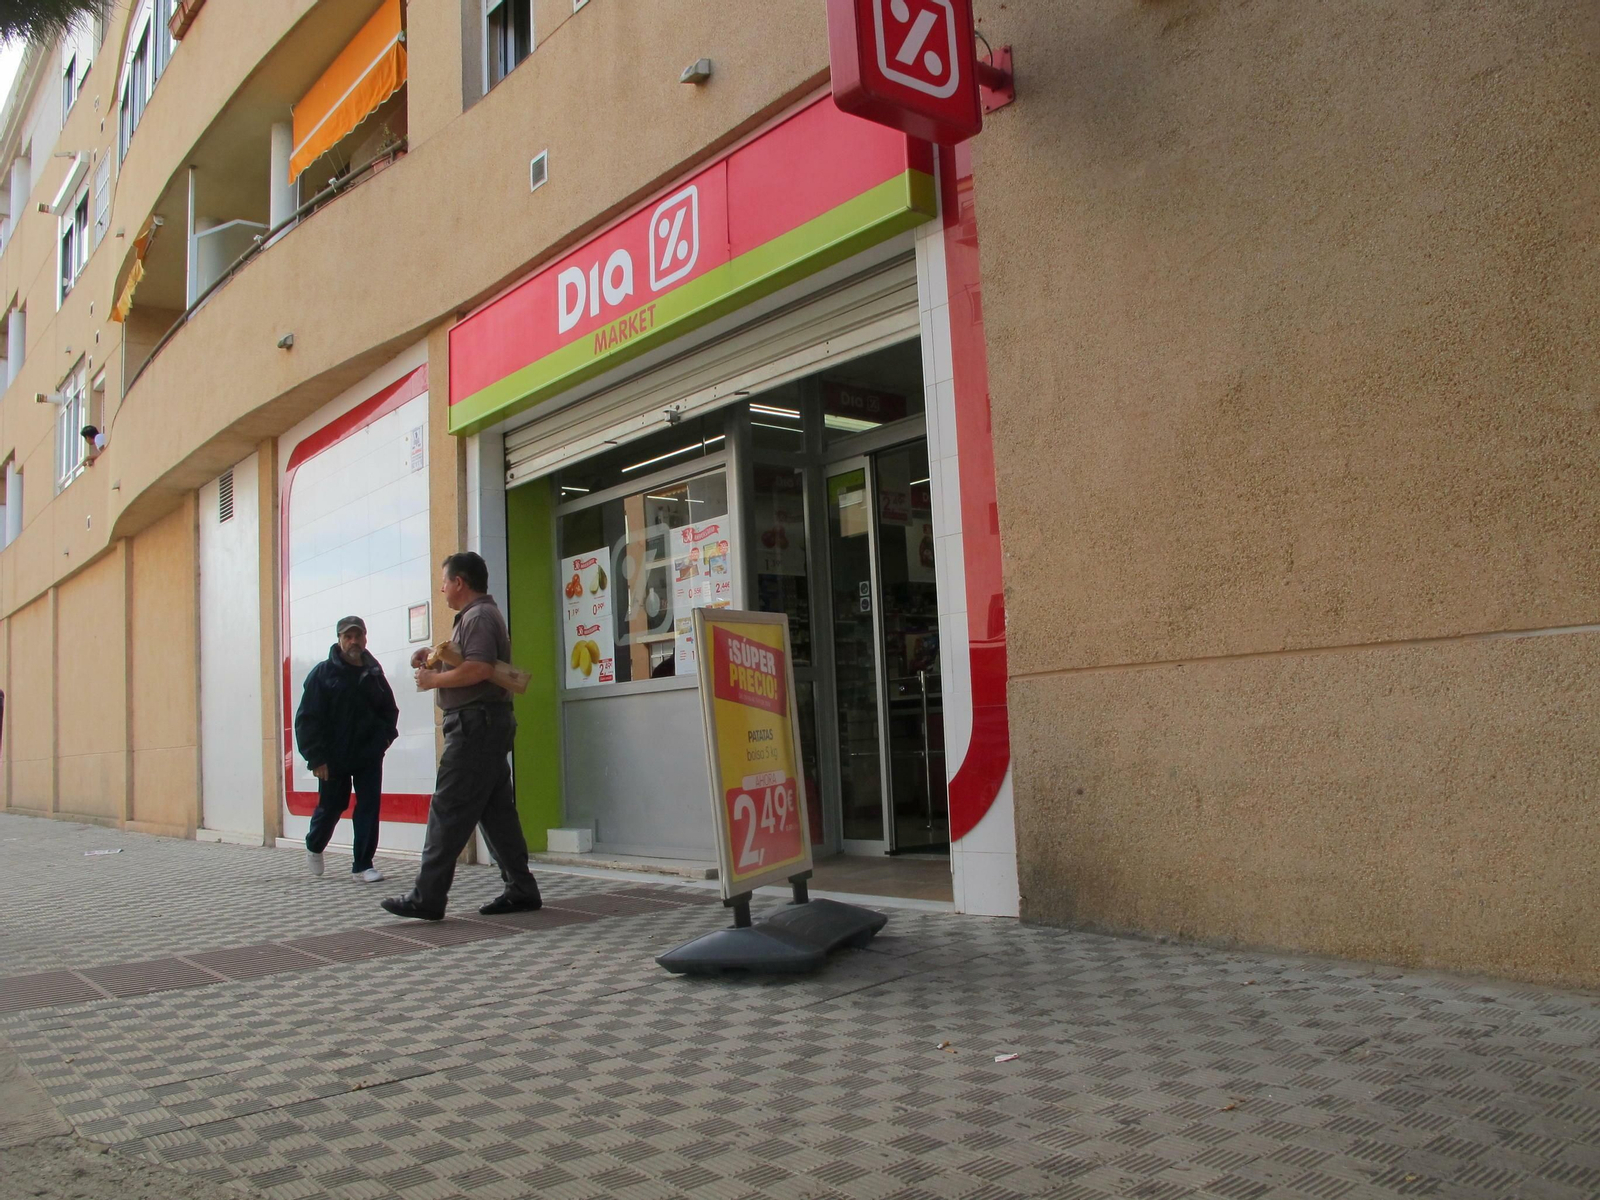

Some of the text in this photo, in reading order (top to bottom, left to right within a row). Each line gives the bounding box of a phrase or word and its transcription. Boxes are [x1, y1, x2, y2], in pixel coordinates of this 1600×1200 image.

[594, 304, 657, 355] MARKET
[728, 637, 776, 676] ¡SÚPER
[729, 663, 778, 700] PRECIO!
[747, 728, 774, 742] PATATAS
[765, 745, 770, 759] 5
[770, 746, 778, 760] kg
[755, 773, 777, 786] AHORA
